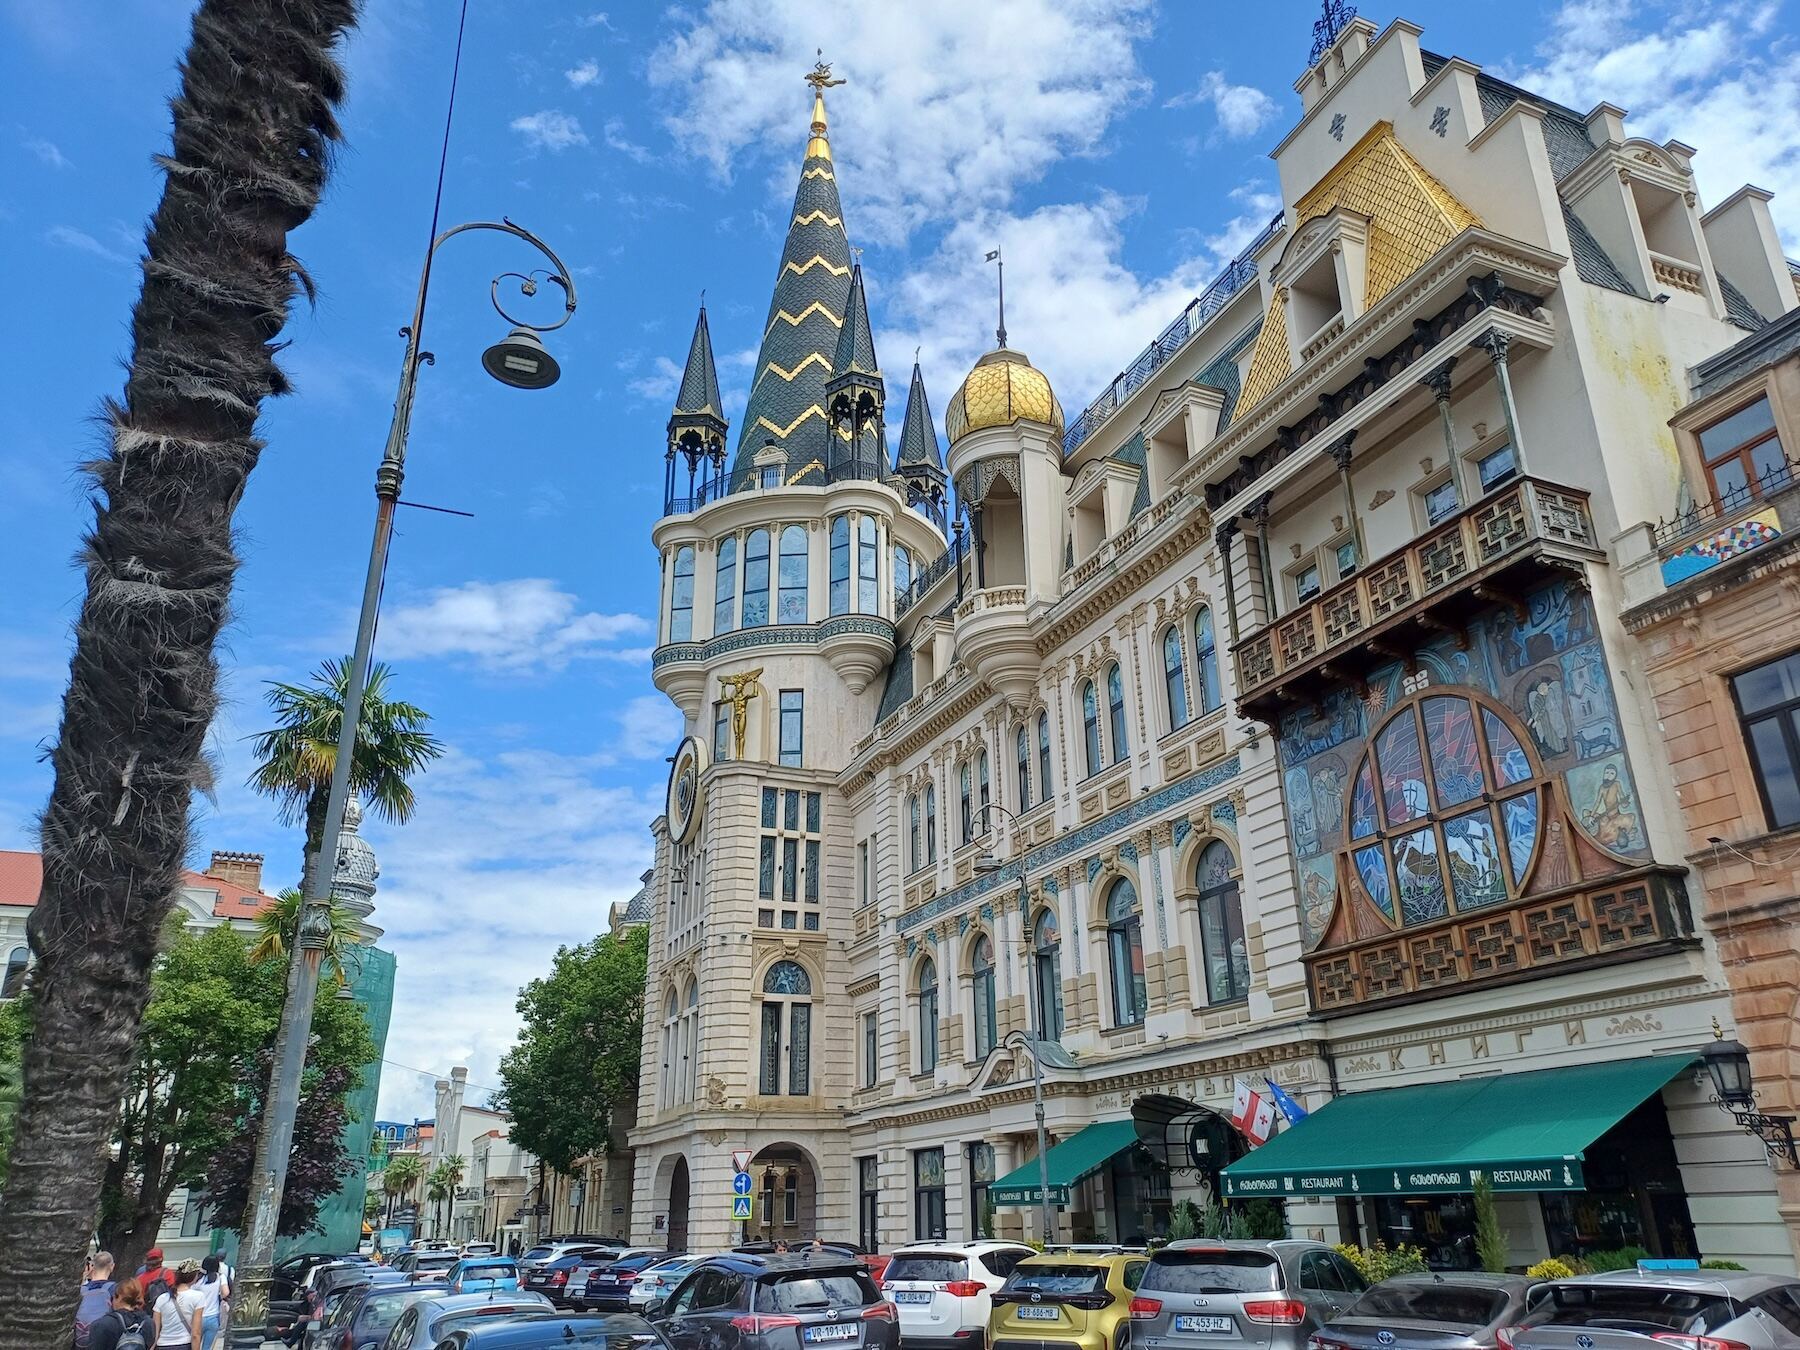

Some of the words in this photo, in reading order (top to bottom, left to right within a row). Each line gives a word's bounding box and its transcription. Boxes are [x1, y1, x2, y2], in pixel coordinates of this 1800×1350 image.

[1388, 1019, 1586, 1071] КНИГИ
[1196, 1139, 1209, 1154] BK
[1409, 1172, 1461, 1185] რესტორანი
[1493, 1168, 1552, 1183] RESTAURANT
[1239, 1179, 1278, 1191] რესტორანი
[1284, 1177, 1295, 1191] BK
[1301, 1177, 1344, 1189] RESTAURANT
[1424, 1210, 1445, 1233] BK
[1195, 1299, 1209, 1307] KIA
[1182, 1317, 1224, 1329] HZ-453-HZ
[811, 1325, 852, 1338] VR-191-VV
